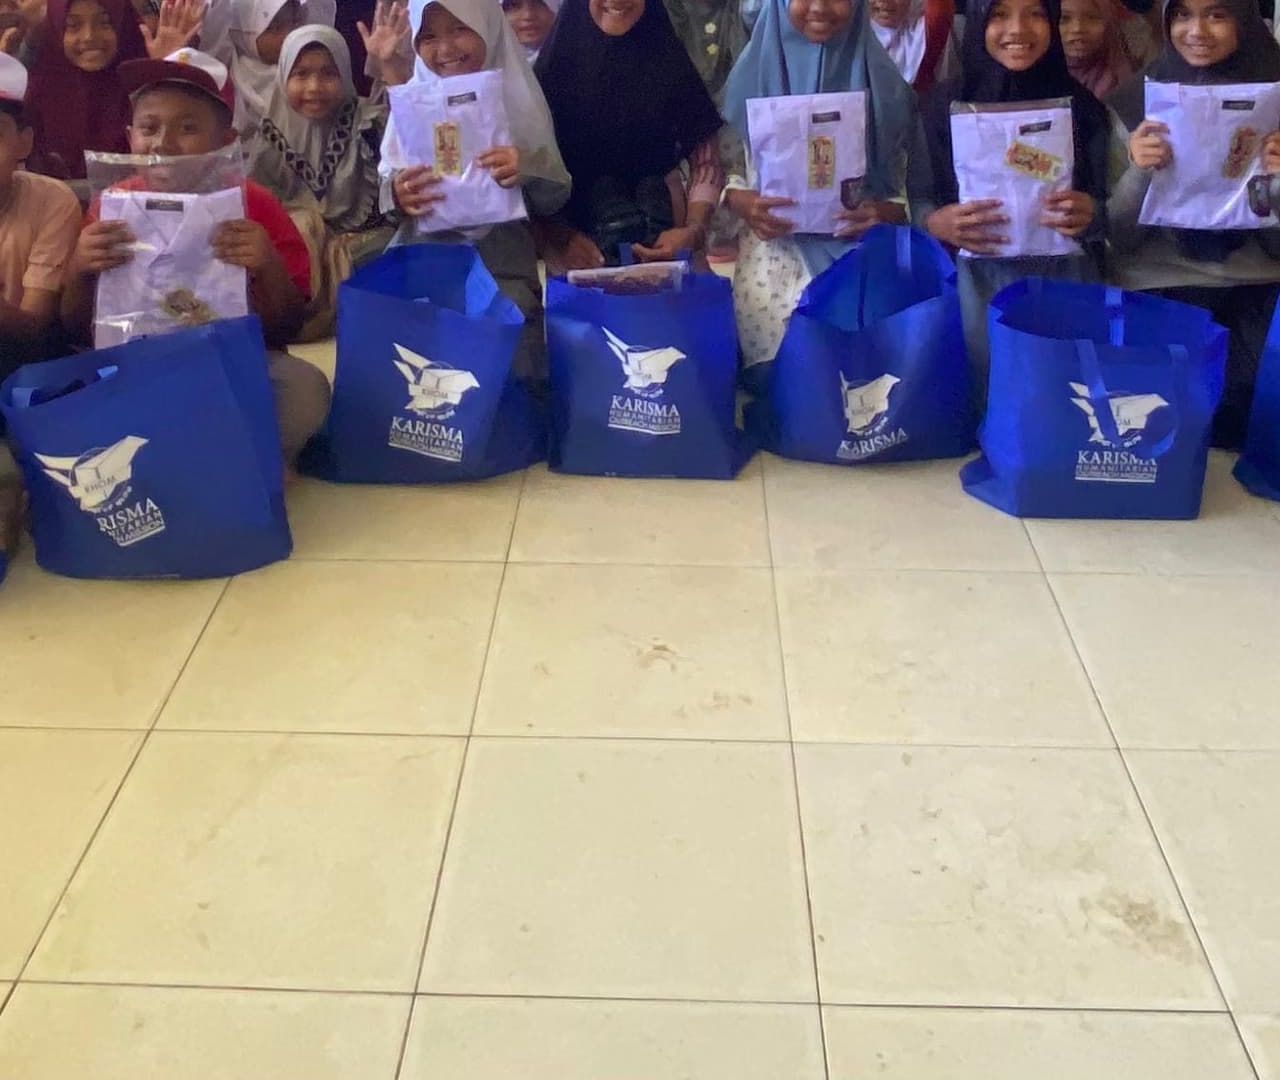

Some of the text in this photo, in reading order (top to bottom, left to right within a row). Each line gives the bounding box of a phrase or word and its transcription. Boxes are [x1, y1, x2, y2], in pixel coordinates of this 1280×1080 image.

[612, 395, 679, 417] KARISMA
[392, 416, 463, 444] KARISMA
[840, 428, 907, 454] KARISMA
[97, 498, 159, 530] RISMA
